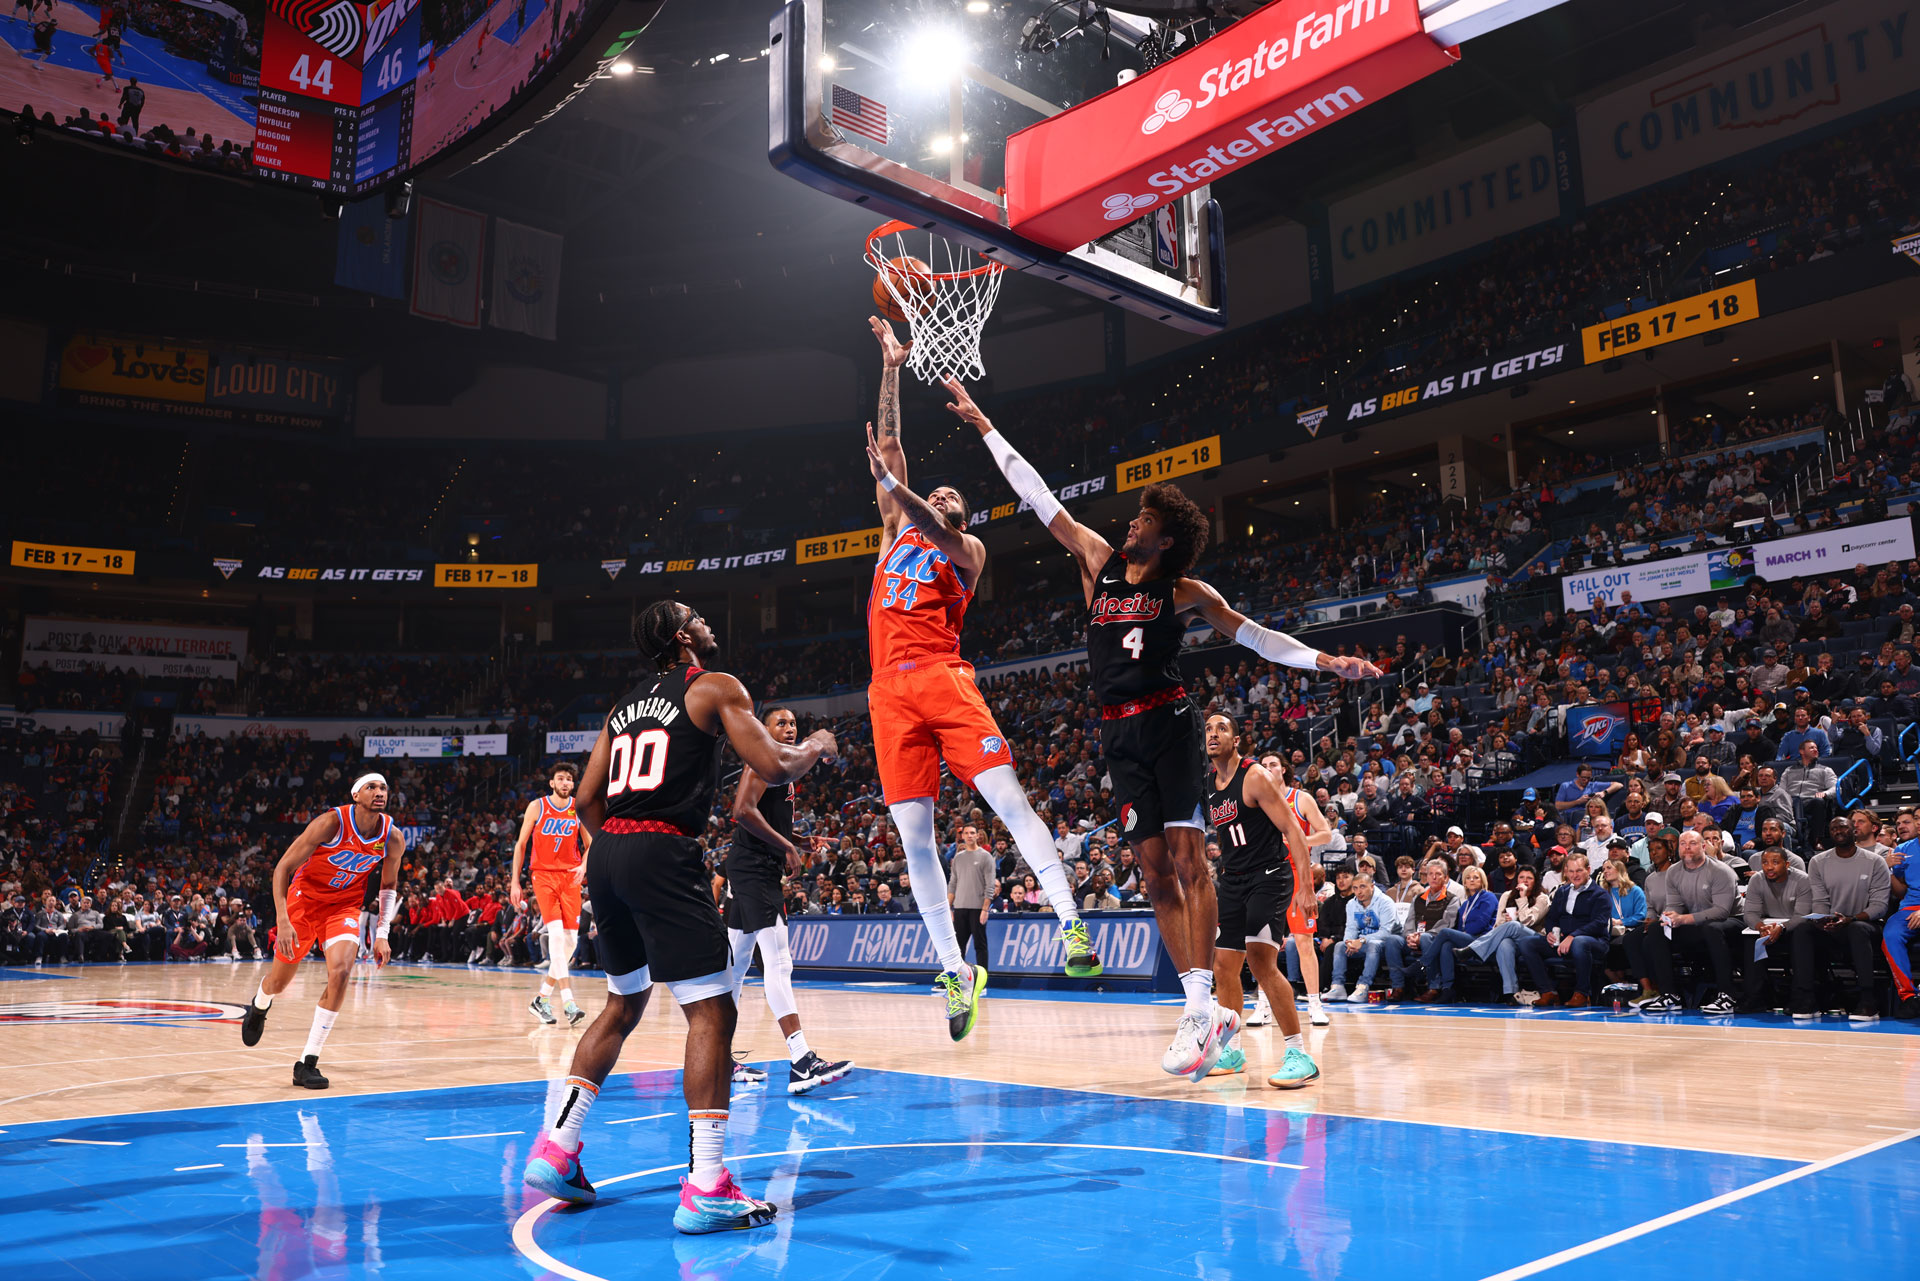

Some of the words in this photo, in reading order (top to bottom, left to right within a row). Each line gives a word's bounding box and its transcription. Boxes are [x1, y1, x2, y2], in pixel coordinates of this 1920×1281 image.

[289, 54, 333, 95] 44
[377, 48, 402, 90] 46
[1613, 12, 1908, 159] COMMUNITY
[259, 103, 300, 118] HENDERSON
[262, 90, 287, 103] PLAYER
[334, 107, 347, 116] PTS
[349, 108, 357, 118] FL
[259, 116, 291, 130] THYBULLE
[258, 129, 290, 142] BROGDON
[256, 142, 278, 153] REATH
[256, 155, 282, 167] WALKER
[332, 171, 341, 179] 10
[259, 169, 268, 177] TO
[282, 173, 290, 181] TF
[312, 180, 325, 189] 2ND
[332, 184, 347, 193] 7:16
[1340, 154, 1551, 261] COMMITTED
[1599, 322, 1640, 351] FEB
[1649, 312, 1677, 337] 17
[1708, 294, 1738, 320] 18
[213, 363, 277, 397] LOUD
[287, 366, 337, 409] CITY
[1347, 399, 1376, 421] AS
[1381, 386, 1419, 412] BIG
[1422, 376, 1454, 400] AS
[1461, 367, 1487, 389] IT
[1491, 344, 1564, 381] GETS!
[80, 394, 126, 408] BRING
[131, 400, 160, 412] THE
[164, 404, 233, 419] THUNDER
[256, 413, 288, 425] EXIT
[291, 417, 323, 429] NOW
[1126, 464, 1152, 483] FEB
[1156, 456, 1173, 475] 17
[1191, 446, 1210, 465] 18
[1448, 453, 1457, 490] 222
[970, 510, 989, 527] AS
[991, 502, 1015, 520] BIG
[1060, 476, 1106, 500] GETS!
[805, 542, 828, 557] FEB
[832, 539, 847, 554] 17
[864, 534, 880, 548] 18
[1766, 550, 1811, 567] MARCH
[1815, 547, 1827, 558] 11
[24, 548, 55, 564] FEB
[62, 552, 82, 565] 17
[104, 555, 123, 569] 18
[640, 561, 663, 574] AS
[666, 559, 695, 572] BIG
[697, 558, 720, 571] AS
[724, 556, 740, 568] IT
[743, 549, 786, 567] GETS!
[884, 544, 948, 583] OKC
[258, 566, 284, 579] AS
[287, 568, 319, 580] BIG
[320, 568, 347, 580] AS
[350, 568, 369, 580] IT
[371, 569, 423, 581] GETS!
[444, 569, 471, 582] FEB
[476, 569, 494, 582] 17
[512, 570, 528, 582] 18
[1569, 577, 1600, 595] FALL
[1603, 572, 1631, 587] OUT
[882, 577, 918, 611] 34
[1586, 588, 1615, 605] BOY
[1091, 592, 1163, 626] ripcity
[48, 632, 80, 646] POST
[99, 634, 123, 649] OAK
[128, 636, 170, 651] PARTY
[175, 639, 232, 655] TERRACE
[1122, 626, 1144, 659] 4
[55, 658, 77, 669] POST
[163, 664, 184, 674] POST
[195, 666, 211, 675] OAK
[610, 697, 680, 735] HENDERSON
[550, 735, 567, 744] FALL
[569, 734, 585, 742] OUT
[1584, 718, 1608, 739] OKC
[368, 739, 387, 748] FALL
[389, 739, 405, 747] OUT
[378, 747, 396, 755] BOY
[607, 728, 671, 798] 00
[541, 818, 576, 837] OKC
[1229, 823, 1247, 847] 11
[553, 837, 563, 853] 7
[328, 850, 382, 873] OKC
[328, 870, 357, 890] 21
